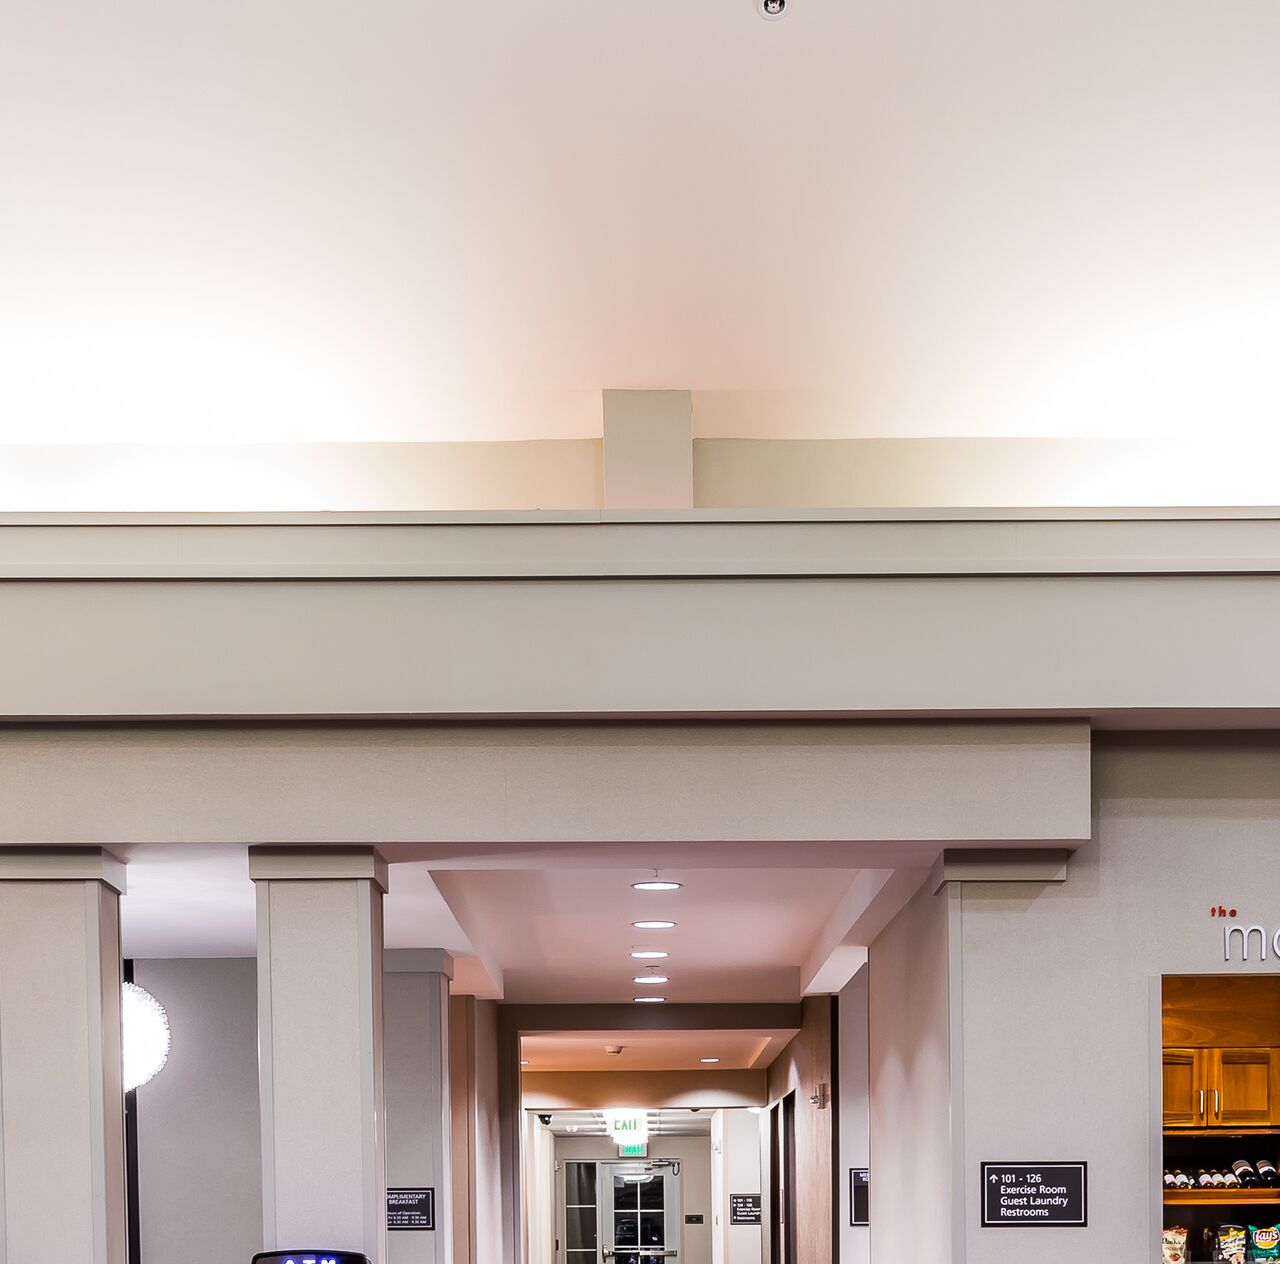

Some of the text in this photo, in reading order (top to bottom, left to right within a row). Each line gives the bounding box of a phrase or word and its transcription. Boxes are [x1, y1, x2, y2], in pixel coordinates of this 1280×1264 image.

[1210, 905, 1238, 918] the
[1000, 1174, 1016, 1183] 101
[1026, 1173, 1042, 1183] 126
[1000, 1185, 1067, 1194] Exercise Room
[1000, 1196, 1069, 1208] Guest Laundry
[1000, 1207, 1049, 1217] Restrooms
